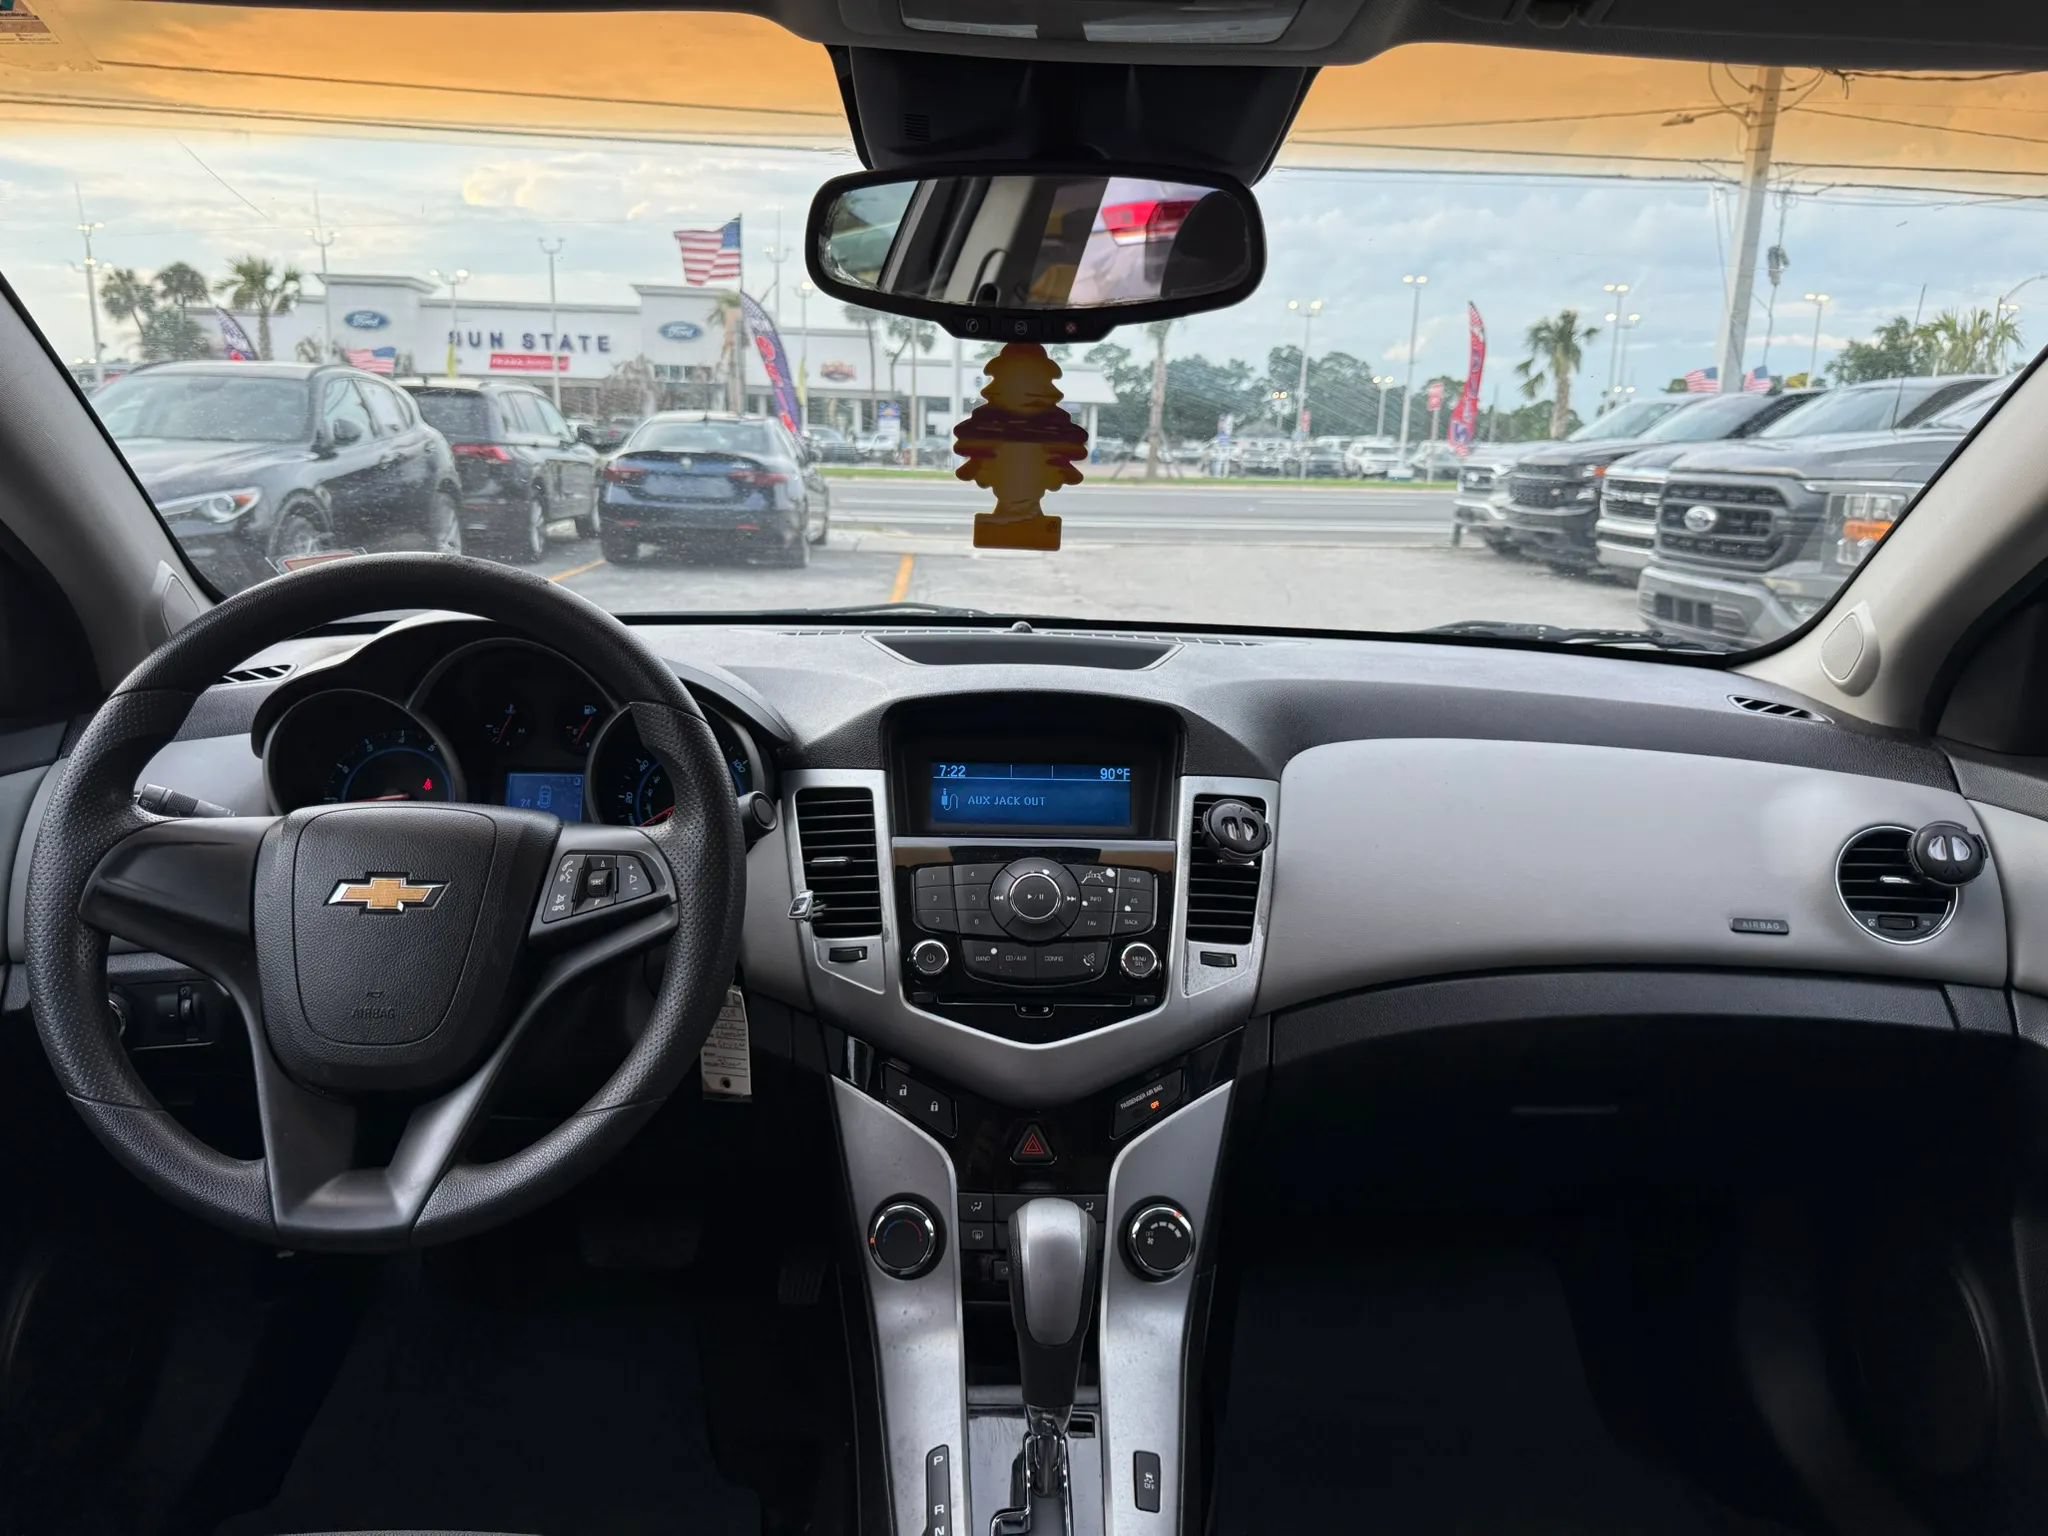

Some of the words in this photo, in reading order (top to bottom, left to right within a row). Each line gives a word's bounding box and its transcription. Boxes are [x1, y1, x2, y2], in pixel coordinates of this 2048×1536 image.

[522, 333, 611, 353] STATE
[940, 765, 966, 777] 7:22
[1100, 768, 1131, 780] 90°F
[968, 796, 990, 805] AUX
[994, 796, 1021, 806] JACK
[1024, 796, 1046, 806] OUT
[1743, 921, 1780, 929] AIRBAG
[351, 1007, 396, 1019] AIRBAG
[933, 1455, 944, 1466] P
[934, 1504, 945, 1516] R
[934, 1526, 945, 1536] N
